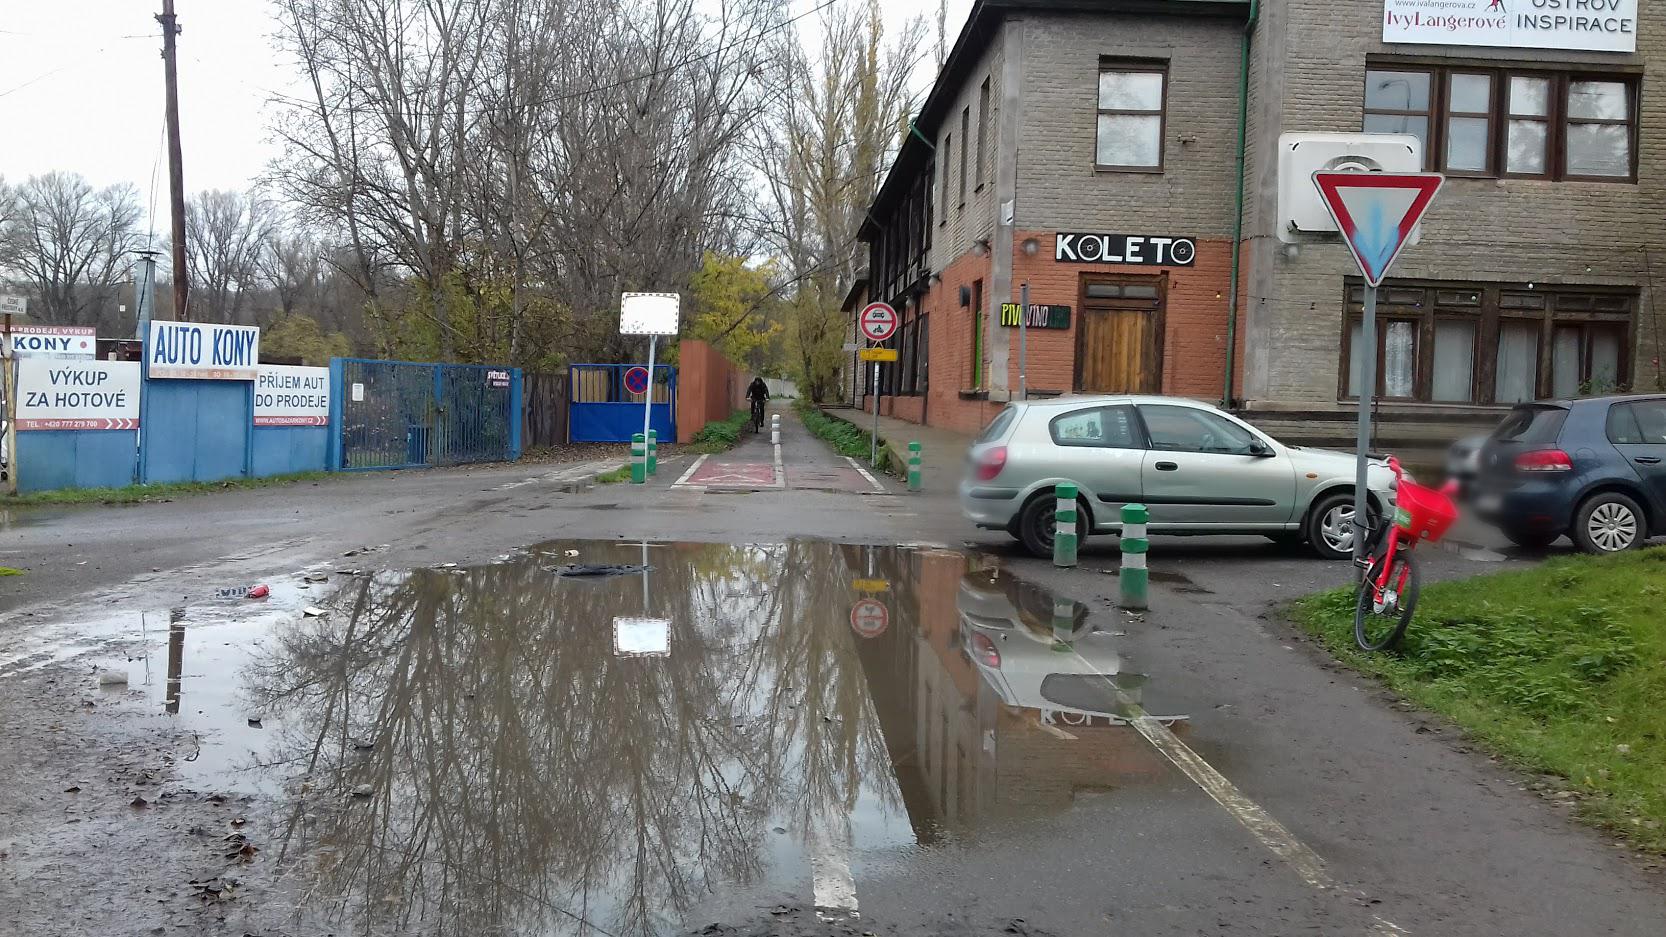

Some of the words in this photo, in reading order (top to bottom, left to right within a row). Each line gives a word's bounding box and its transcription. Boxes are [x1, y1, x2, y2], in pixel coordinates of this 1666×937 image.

[1395, 0, 1477, 9] www.ivalangerova.cz
[1532, 0, 1620, 11] OSTROV
[1517, 13, 1632, 33] INSPIRACE
[1056, 234, 1195, 265] KOLETO
[14, 336, 72, 351] KONY
[154, 325, 202, 365] AUTO
[212, 328, 256, 366] KONY
[49, 366, 108, 386] VÝKUP
[259, 371, 301, 389] PŘÍJEM
[304, 377, 325, 390] AUT
[25, 392, 50, 408] ZA
[55, 389, 126, 408] HOTOVÉ
[255, 394, 273, 407] DO
[276, 394, 327, 408] PRODEJE
